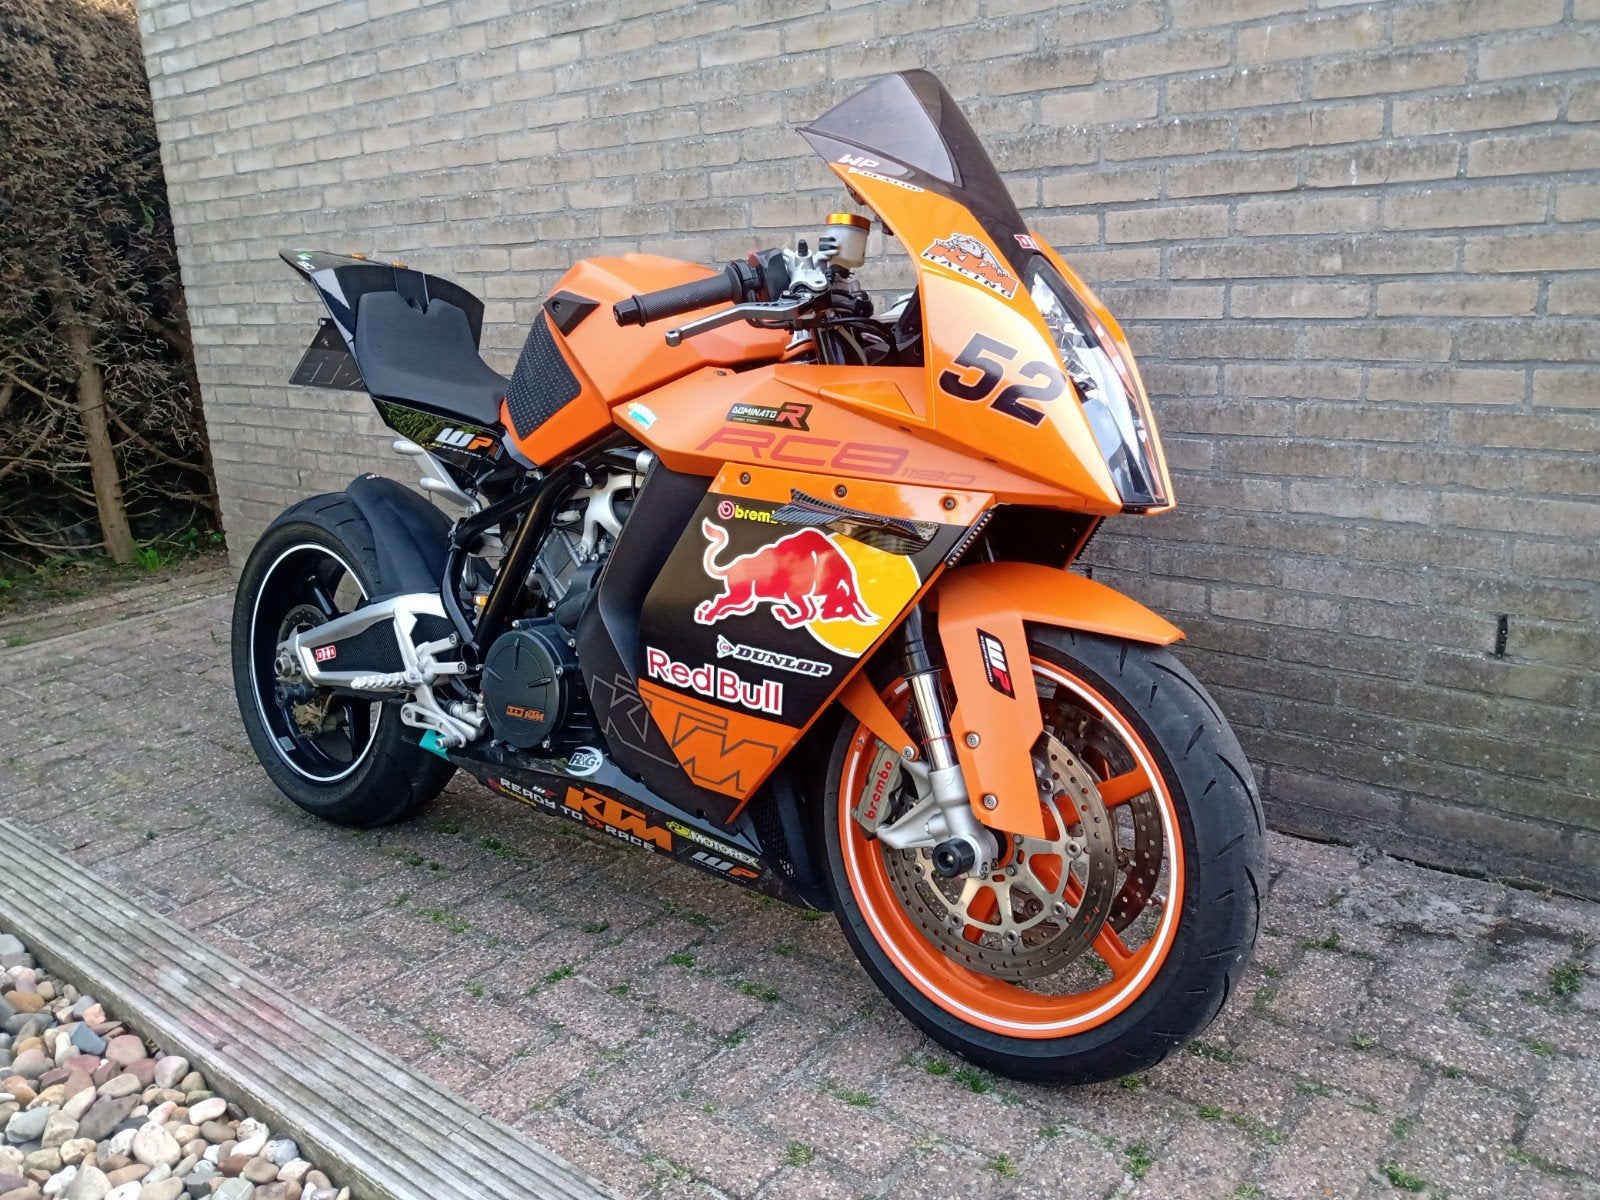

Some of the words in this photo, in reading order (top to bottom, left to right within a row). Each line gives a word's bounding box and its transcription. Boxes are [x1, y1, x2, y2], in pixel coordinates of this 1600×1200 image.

[837, 153, 880, 168] WP
[922, 252, 1013, 298] RACING
[938, 332, 1067, 428] 52
[435, 427, 494, 450] WP
[695, 427, 910, 475] RC8
[901, 466, 978, 486] 1190
[735, 505, 788, 526] brem
[316, 645, 337, 662] DID
[735, 645, 832, 677] DUNLOP
[985, 637, 1011, 692] WP
[569, 751, 600, 768] R&G
[864, 760, 893, 821] brembo
[500, 777, 556, 810] READY
[560, 805, 583, 821] TO
[605, 824, 655, 852] RACE
[564, 786, 672, 851] KTM
[690, 829, 762, 870] MOTOREX
[691, 851, 760, 879] WP
